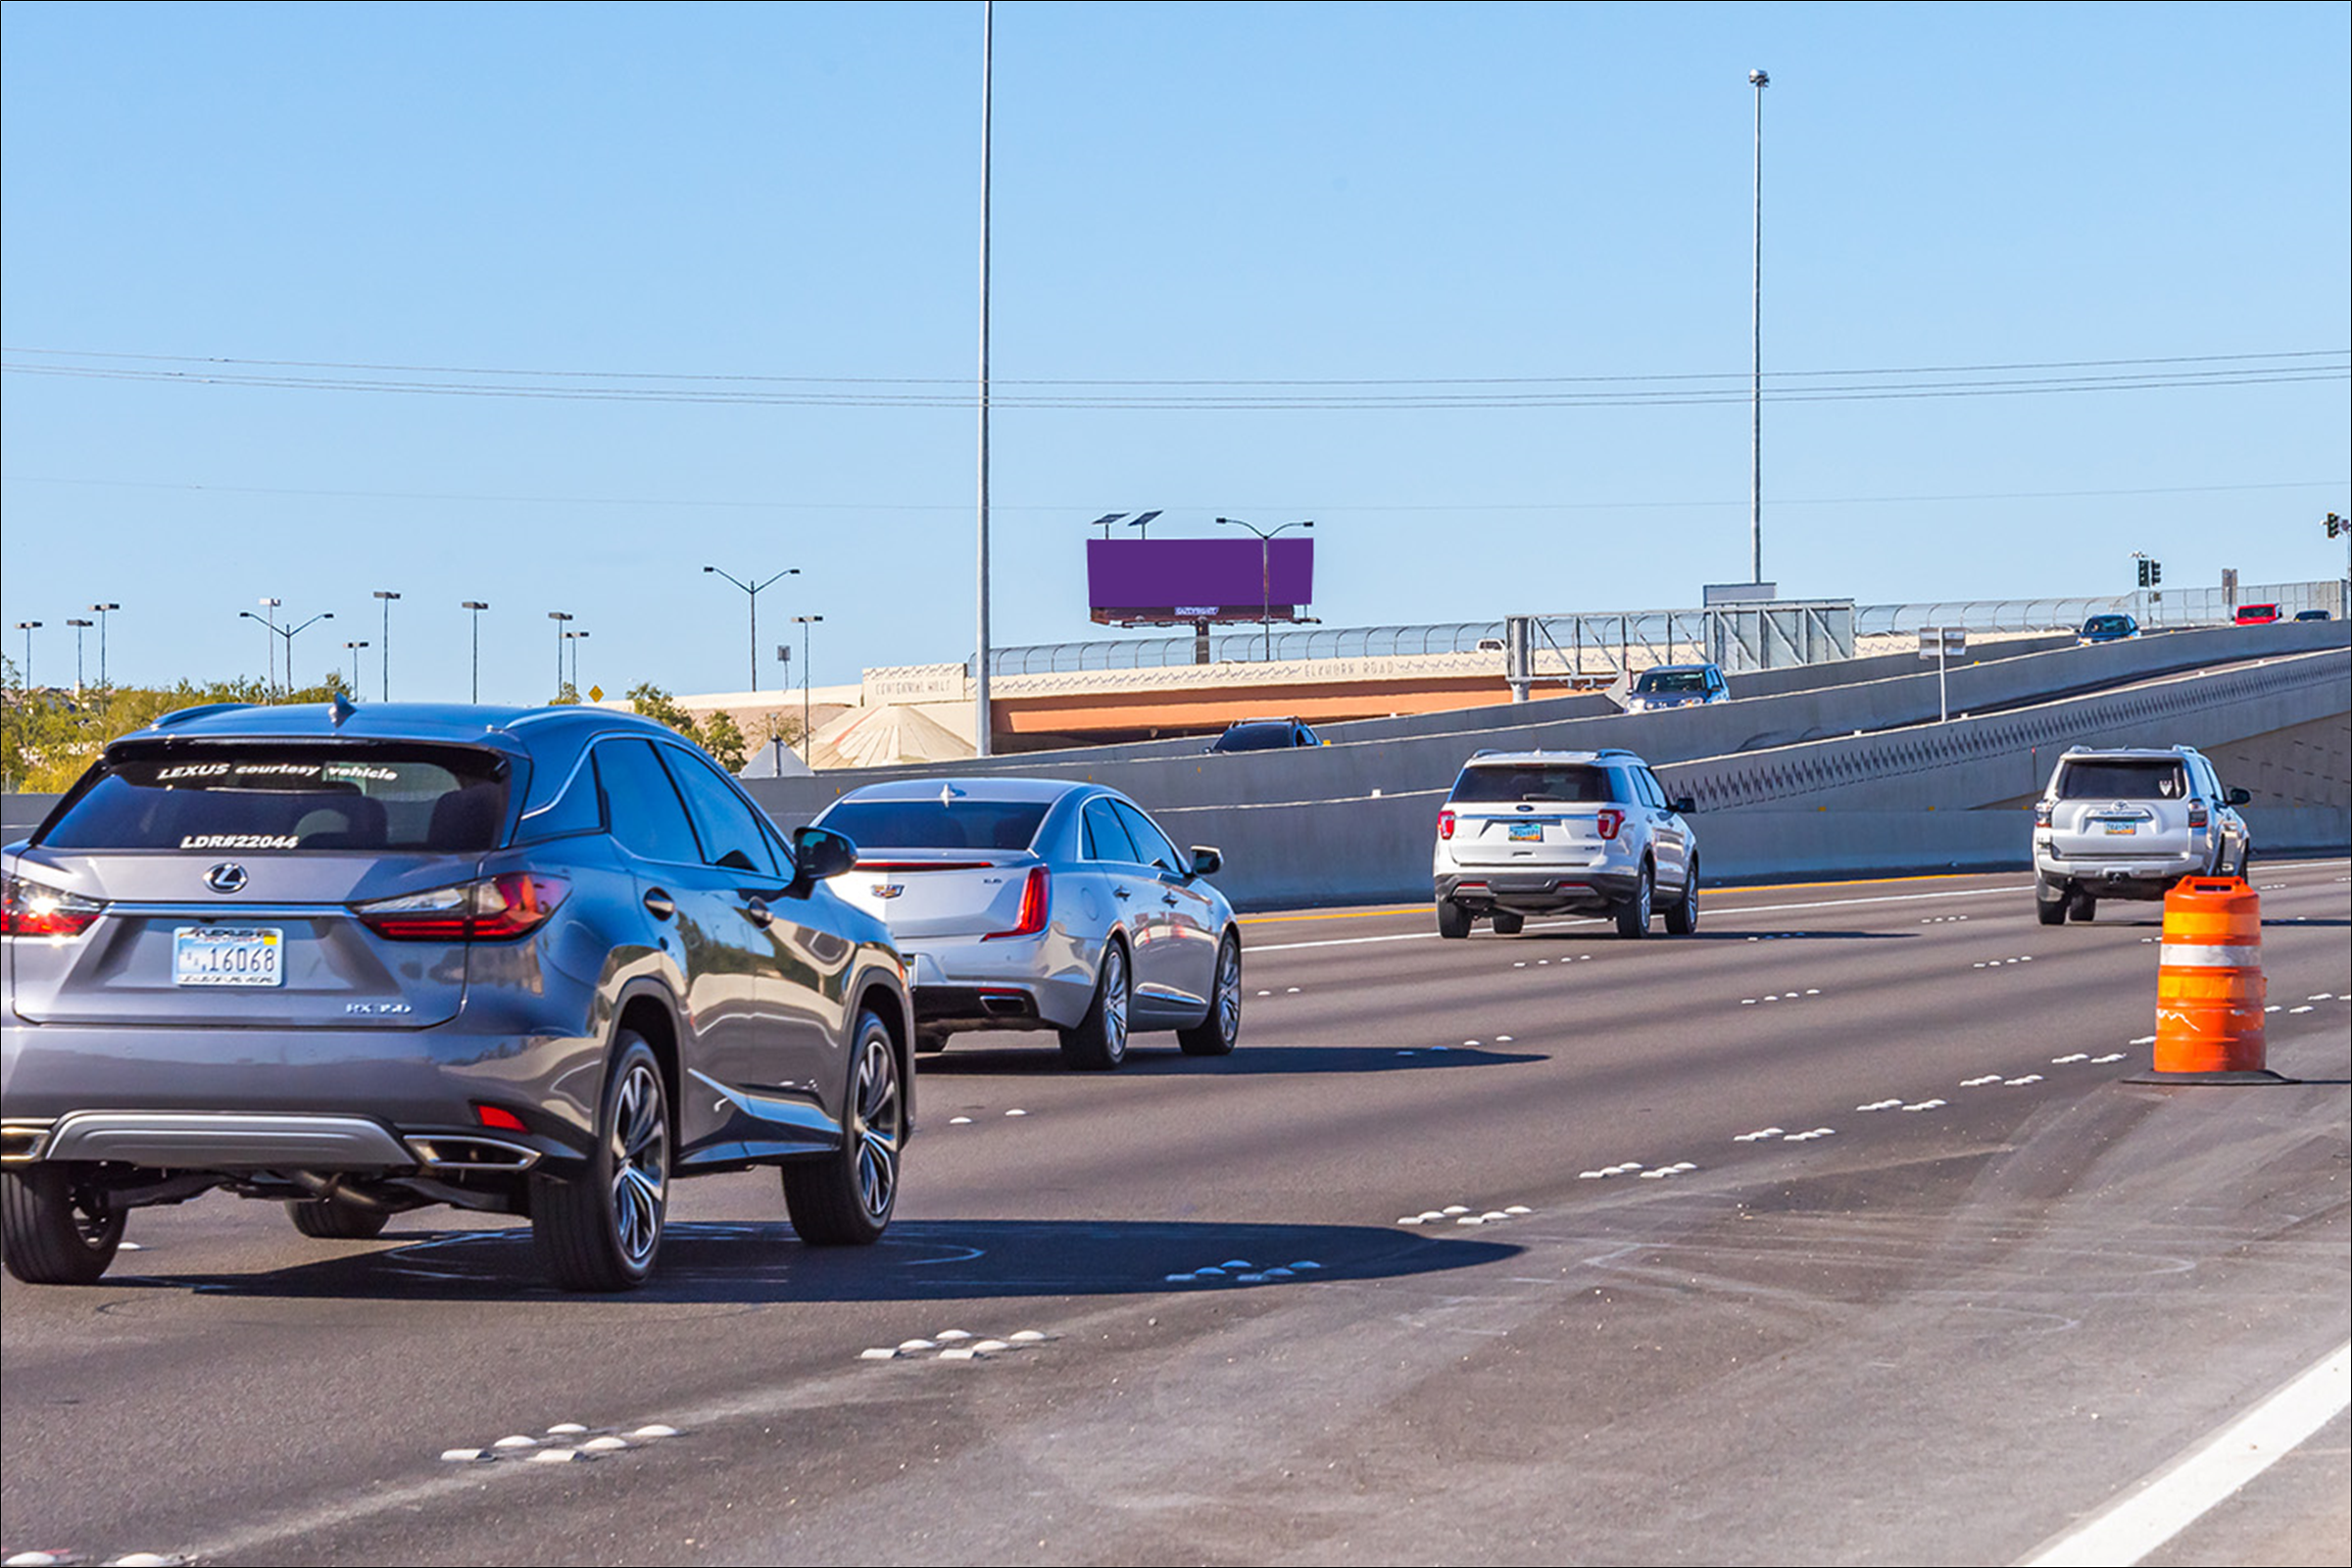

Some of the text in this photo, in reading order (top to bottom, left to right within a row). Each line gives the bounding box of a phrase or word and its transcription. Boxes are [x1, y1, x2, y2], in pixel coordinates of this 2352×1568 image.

[1304, 661, 1394, 677] ELKHORN ROAD
[157, 762, 399, 781] LEXUS courtesy vehicle
[179, 835, 300, 850] LDR#22044
[209, 947, 275, 972] 16068
